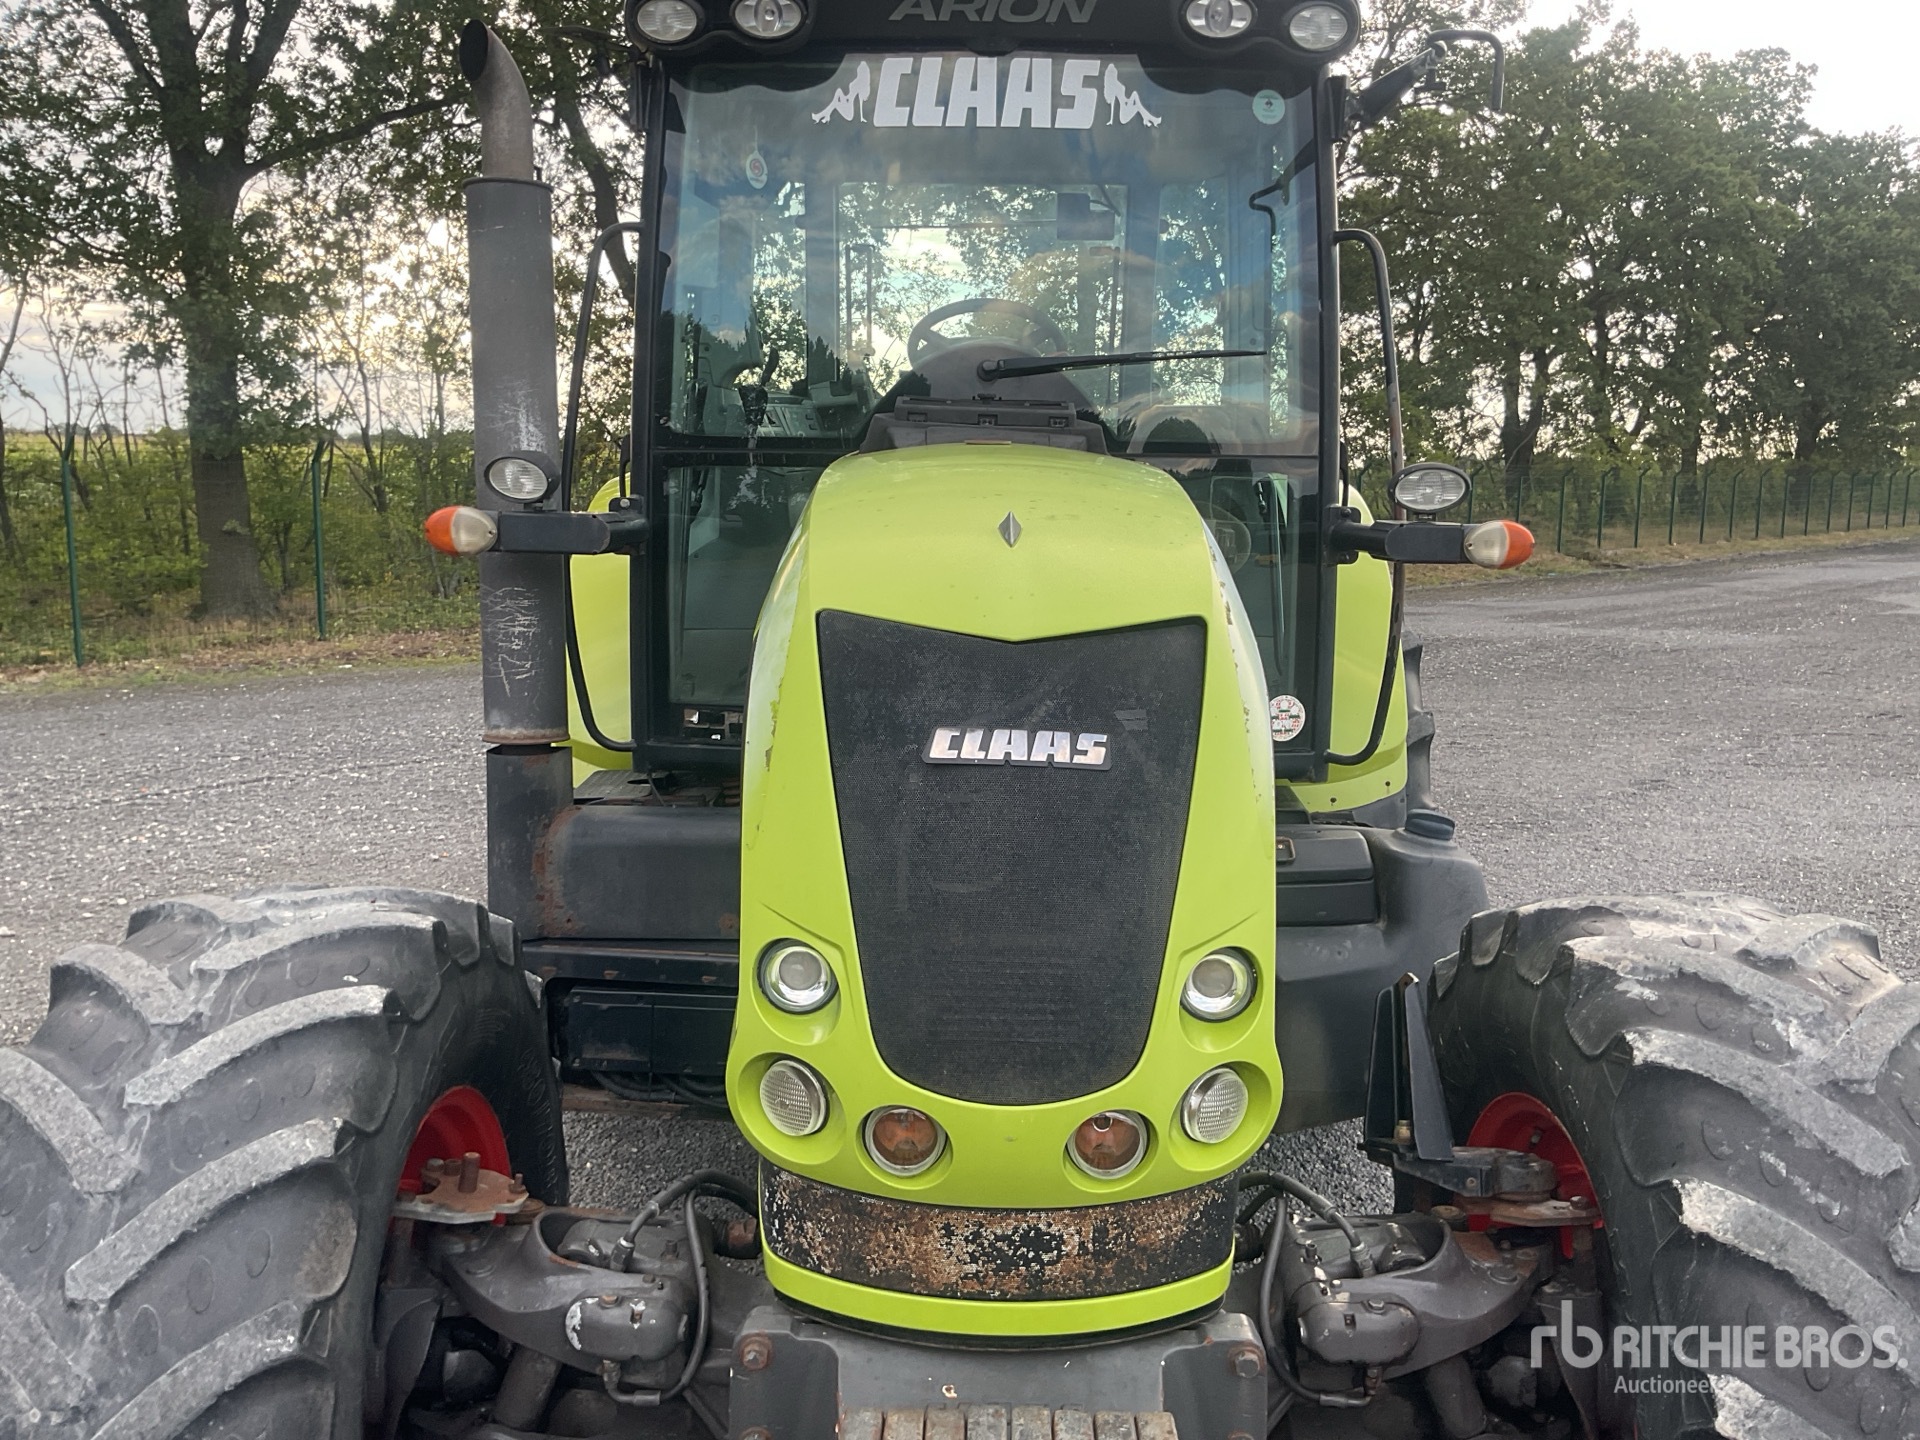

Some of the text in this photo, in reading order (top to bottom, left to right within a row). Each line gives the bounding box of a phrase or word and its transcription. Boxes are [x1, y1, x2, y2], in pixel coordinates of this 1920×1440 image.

[889, 0, 1097, 23] ARION
[873, 57, 1101, 129] CLAAS
[929, 728, 1108, 765] CLAAS
